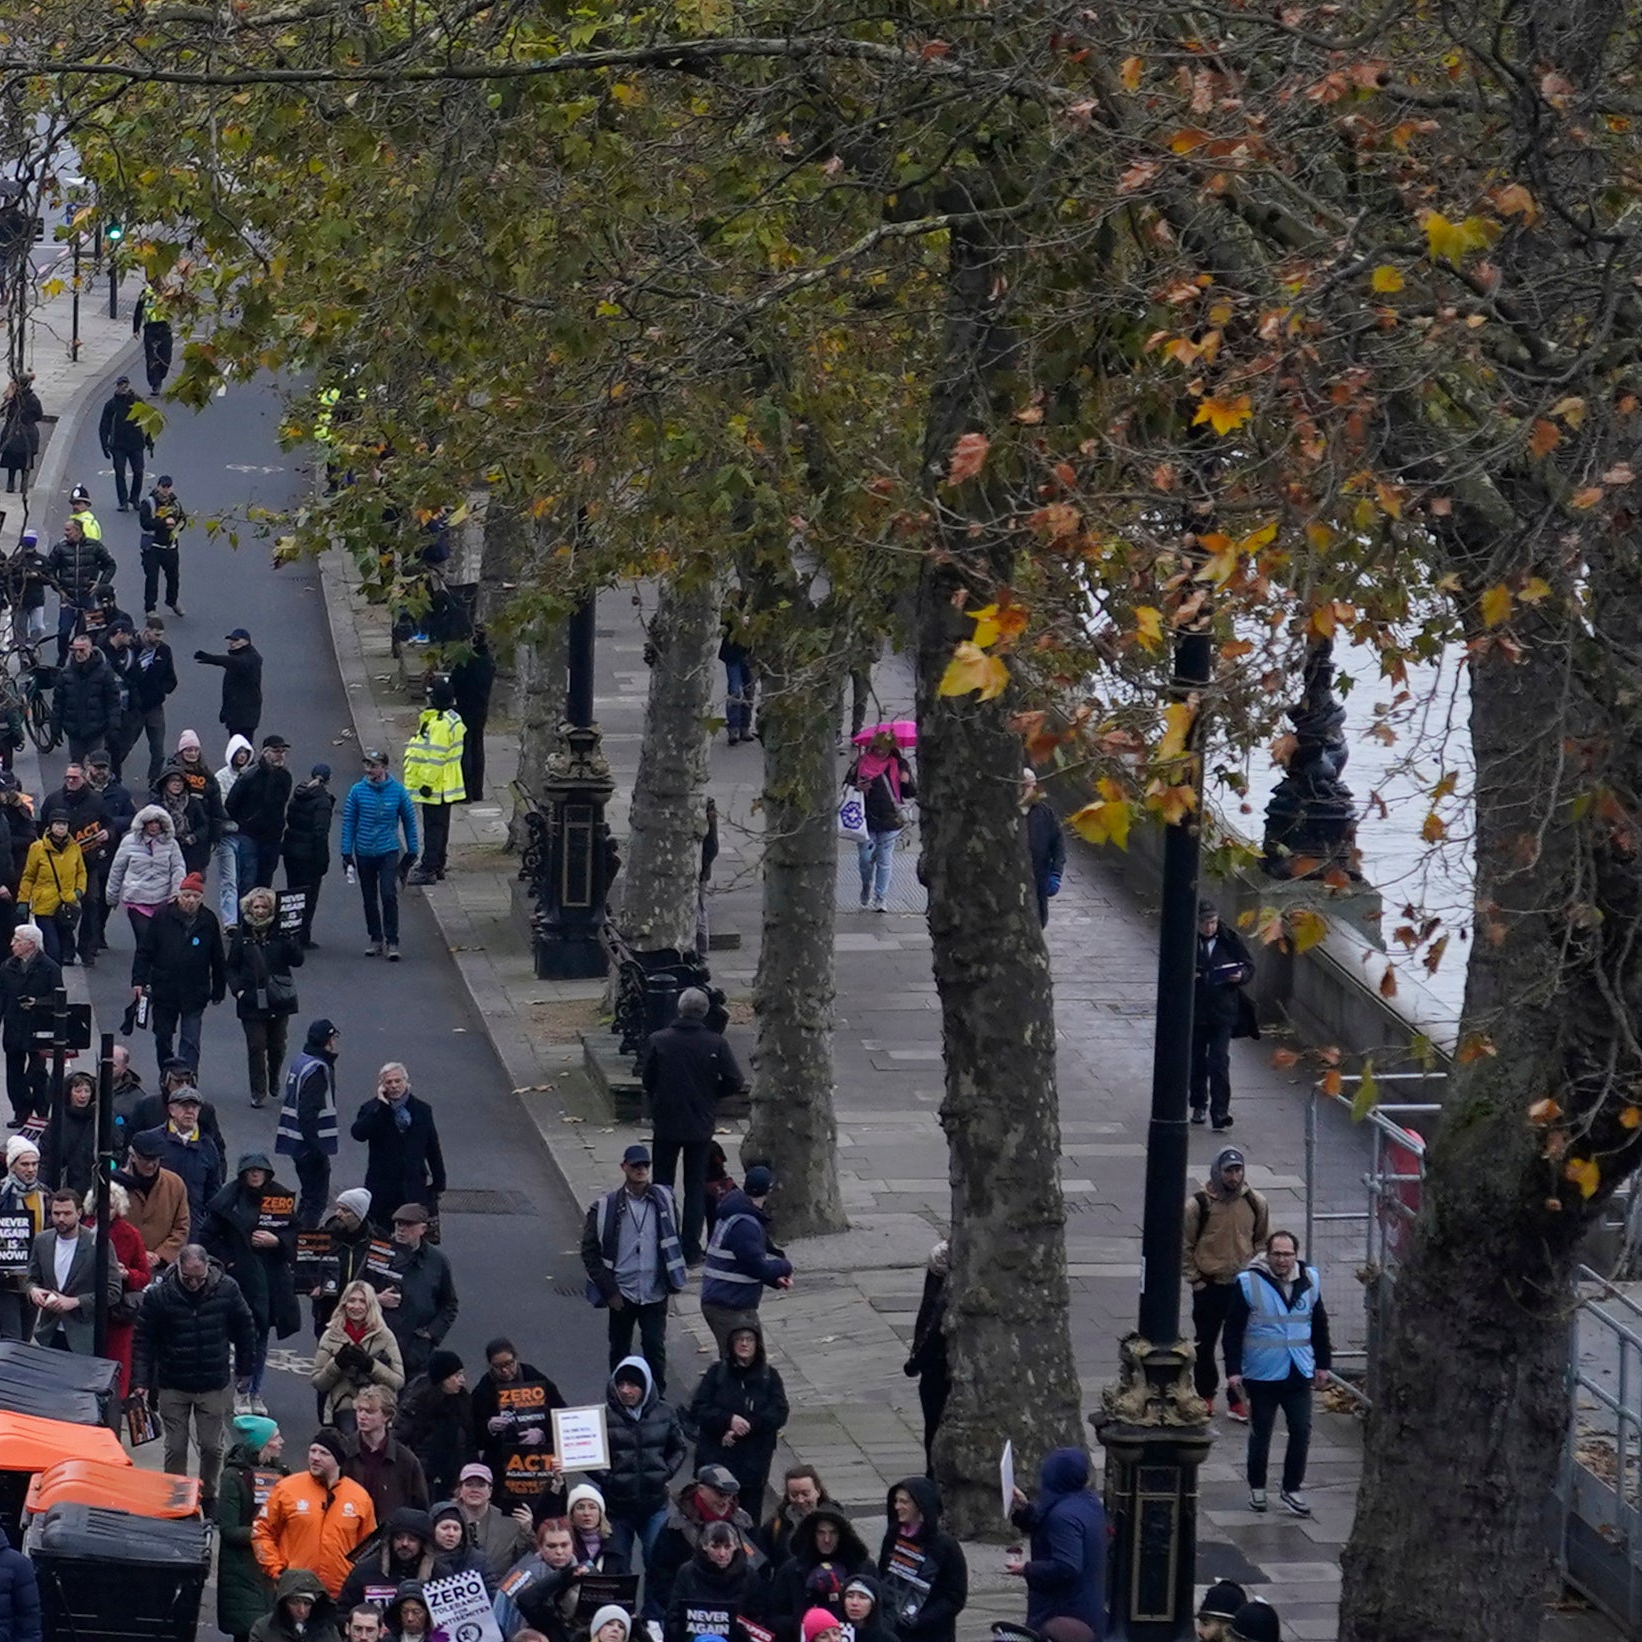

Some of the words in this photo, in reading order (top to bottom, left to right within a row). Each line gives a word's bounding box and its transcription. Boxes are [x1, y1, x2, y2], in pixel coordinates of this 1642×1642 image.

[262, 1197, 294, 1210] ZERO
[7, 1240, 19, 1250] IS
[428, 1581, 482, 1607] ZERO
[687, 1609, 730, 1622] NEVER
[687, 1622, 730, 1636] AGAIN
